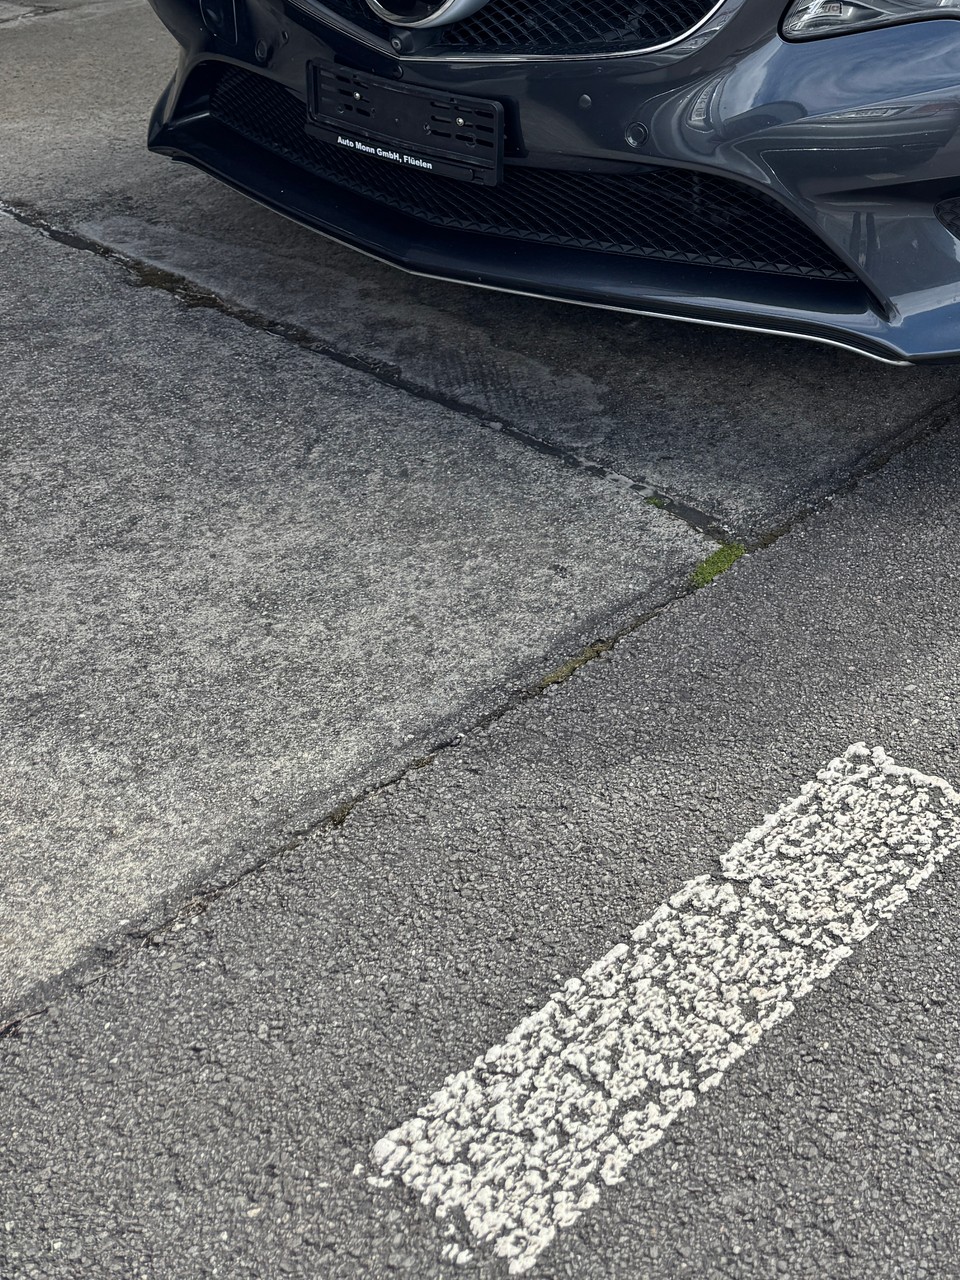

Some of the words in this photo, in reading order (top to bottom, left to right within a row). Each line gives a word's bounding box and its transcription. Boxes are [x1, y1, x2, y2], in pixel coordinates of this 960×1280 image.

[337, 136, 354, 148] Auto
[355, 141, 375, 154] Monn
[376, 146, 402, 162] GmbH,
[403, 155, 433, 170] Flüelen
